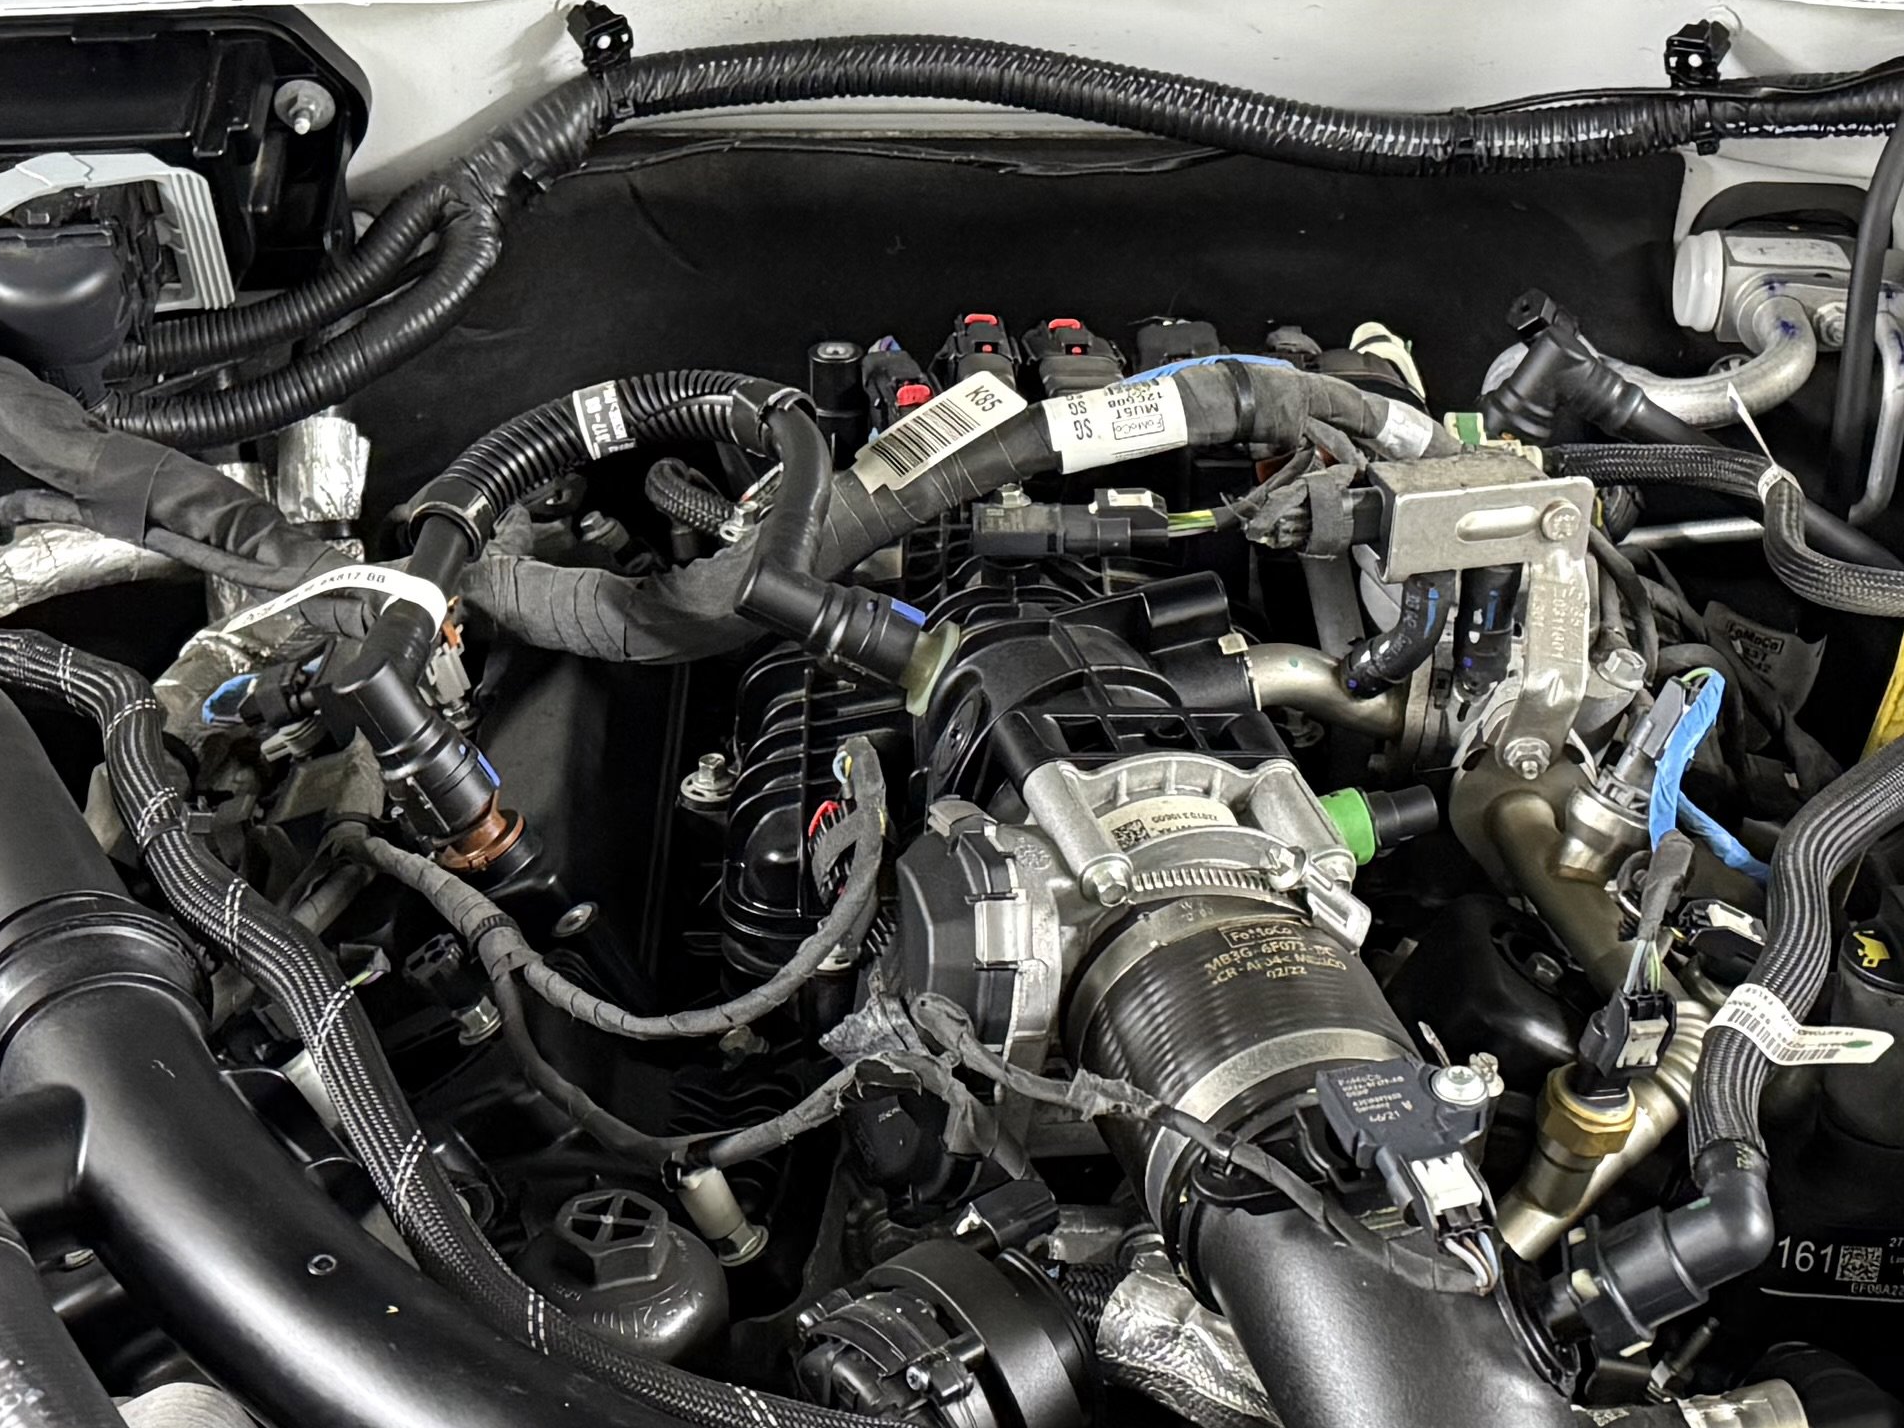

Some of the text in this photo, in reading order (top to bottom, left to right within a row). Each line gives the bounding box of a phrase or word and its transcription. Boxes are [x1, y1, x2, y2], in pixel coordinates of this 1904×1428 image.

[964, 385, 1005, 414] K85
[1068, 400, 1087, 416] SG
[1072, 418, 1093, 441] SG
[1113, 417, 1163, 436] FoMoCo
[1778, 1235, 1834, 1275] 161
